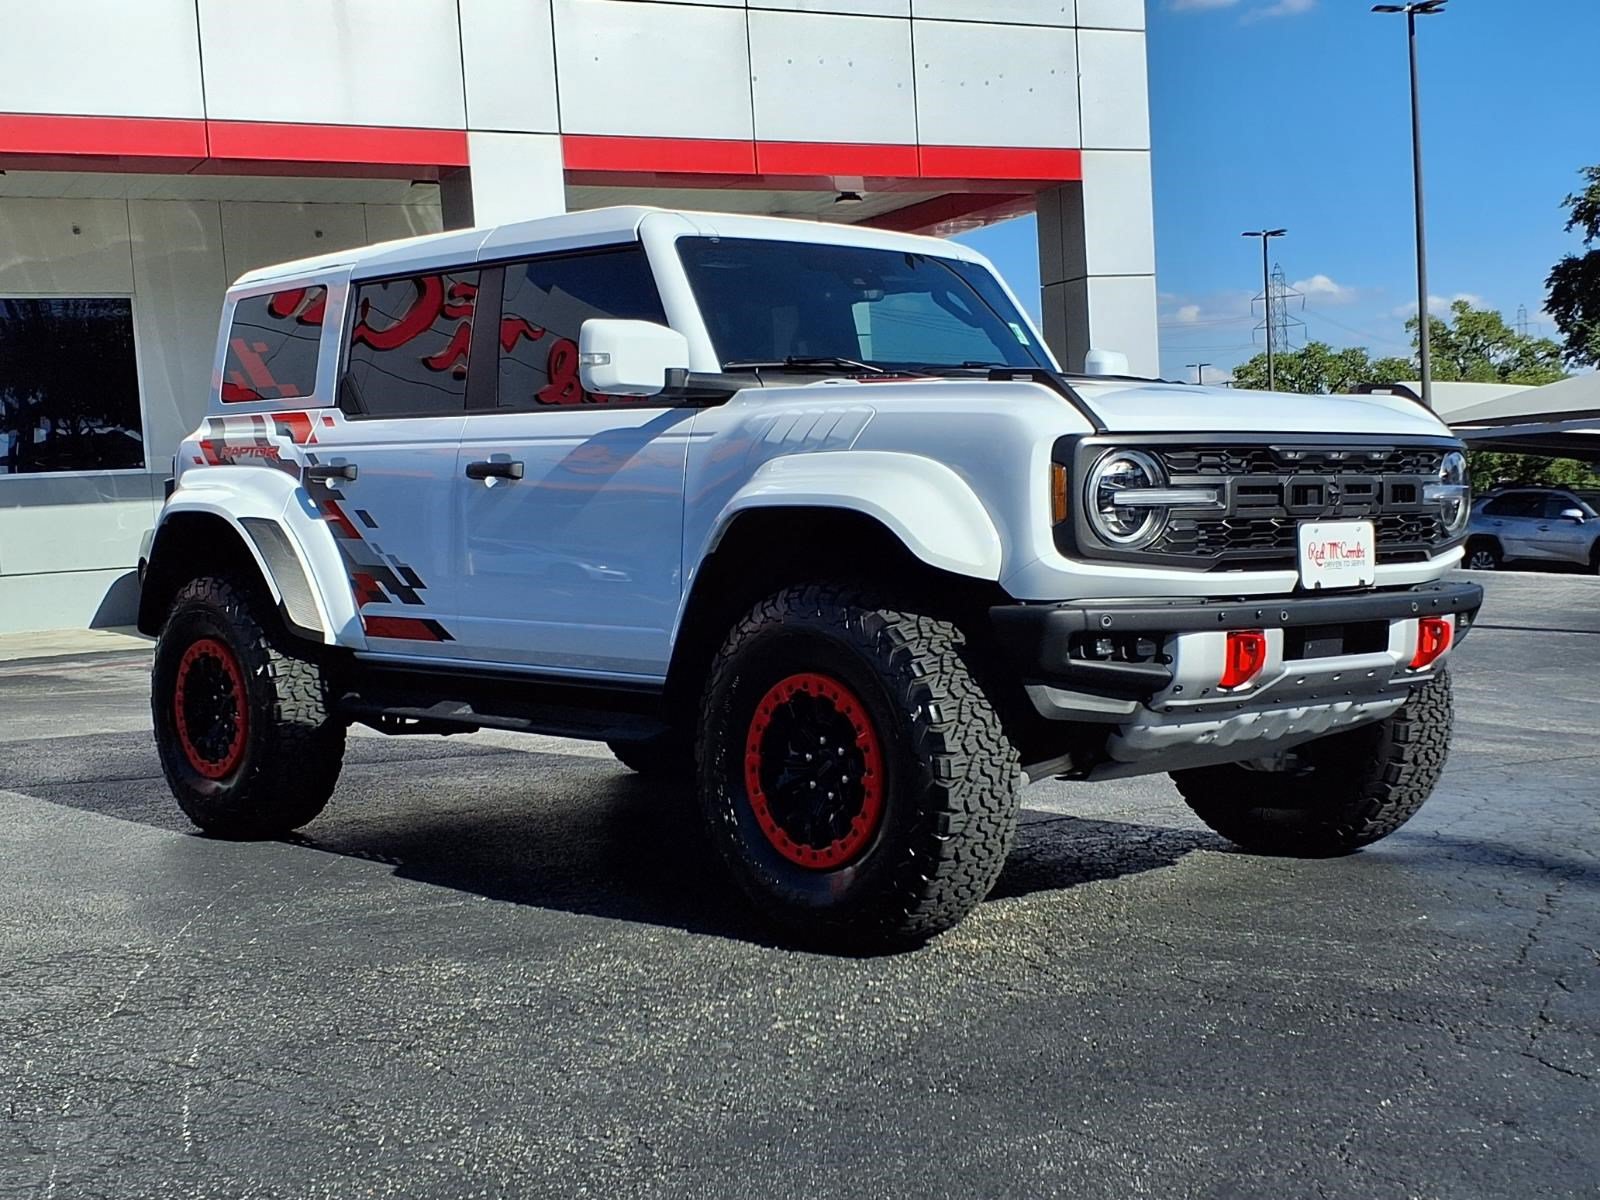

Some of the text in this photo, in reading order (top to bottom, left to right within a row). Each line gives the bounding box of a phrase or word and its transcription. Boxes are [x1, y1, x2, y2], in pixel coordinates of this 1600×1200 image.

[220, 446, 279, 463] RAPTOR
[1228, 475, 1424, 517] FORD
[1308, 541, 1365, 567] Red McCombs
